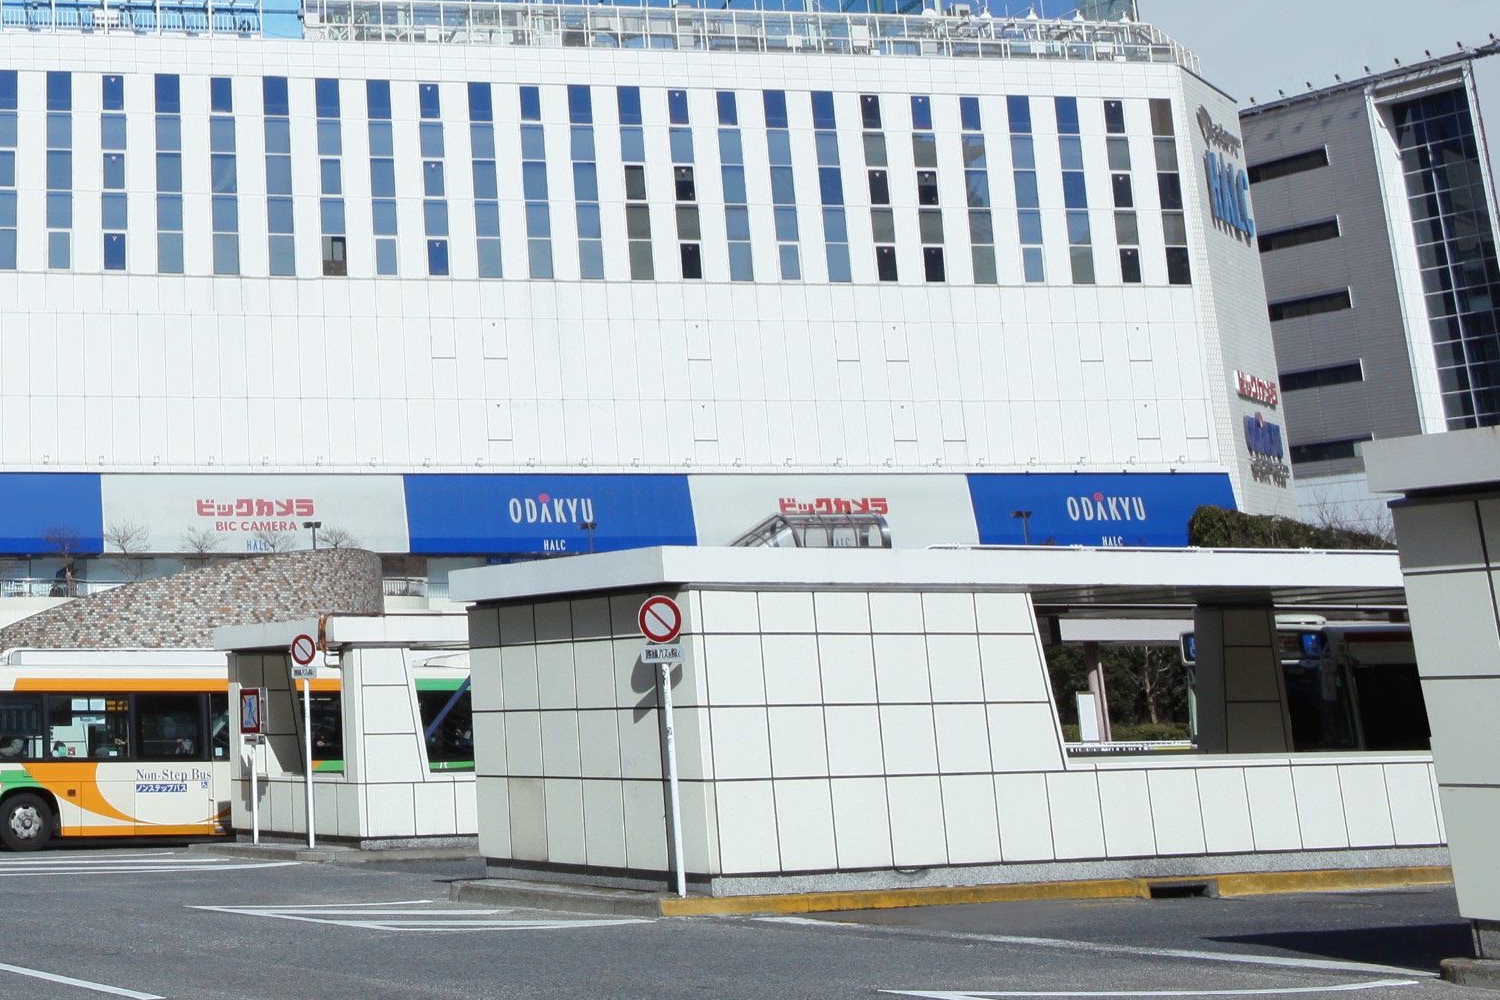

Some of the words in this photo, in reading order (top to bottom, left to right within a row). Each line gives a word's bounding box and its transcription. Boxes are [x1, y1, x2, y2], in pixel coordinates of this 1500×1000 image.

[1204, 149, 1255, 238] HALC
[196, 499, 315, 517] ビックカメラ
[508, 493, 594, 523] ODAKYU
[778, 498, 888, 514] ビックカメラ
[1066, 492, 1146, 521] ODAKYU
[215, 521, 238, 531] BIC
[240, 521, 298, 531] CAMERA
[246, 540, 270, 551] HALC
[543, 539, 566, 551] HALC
[1101, 536, 1123, 547] HALC
[192, 768, 211, 780] Bus
[136, 784, 187, 792] ノンステップバス
